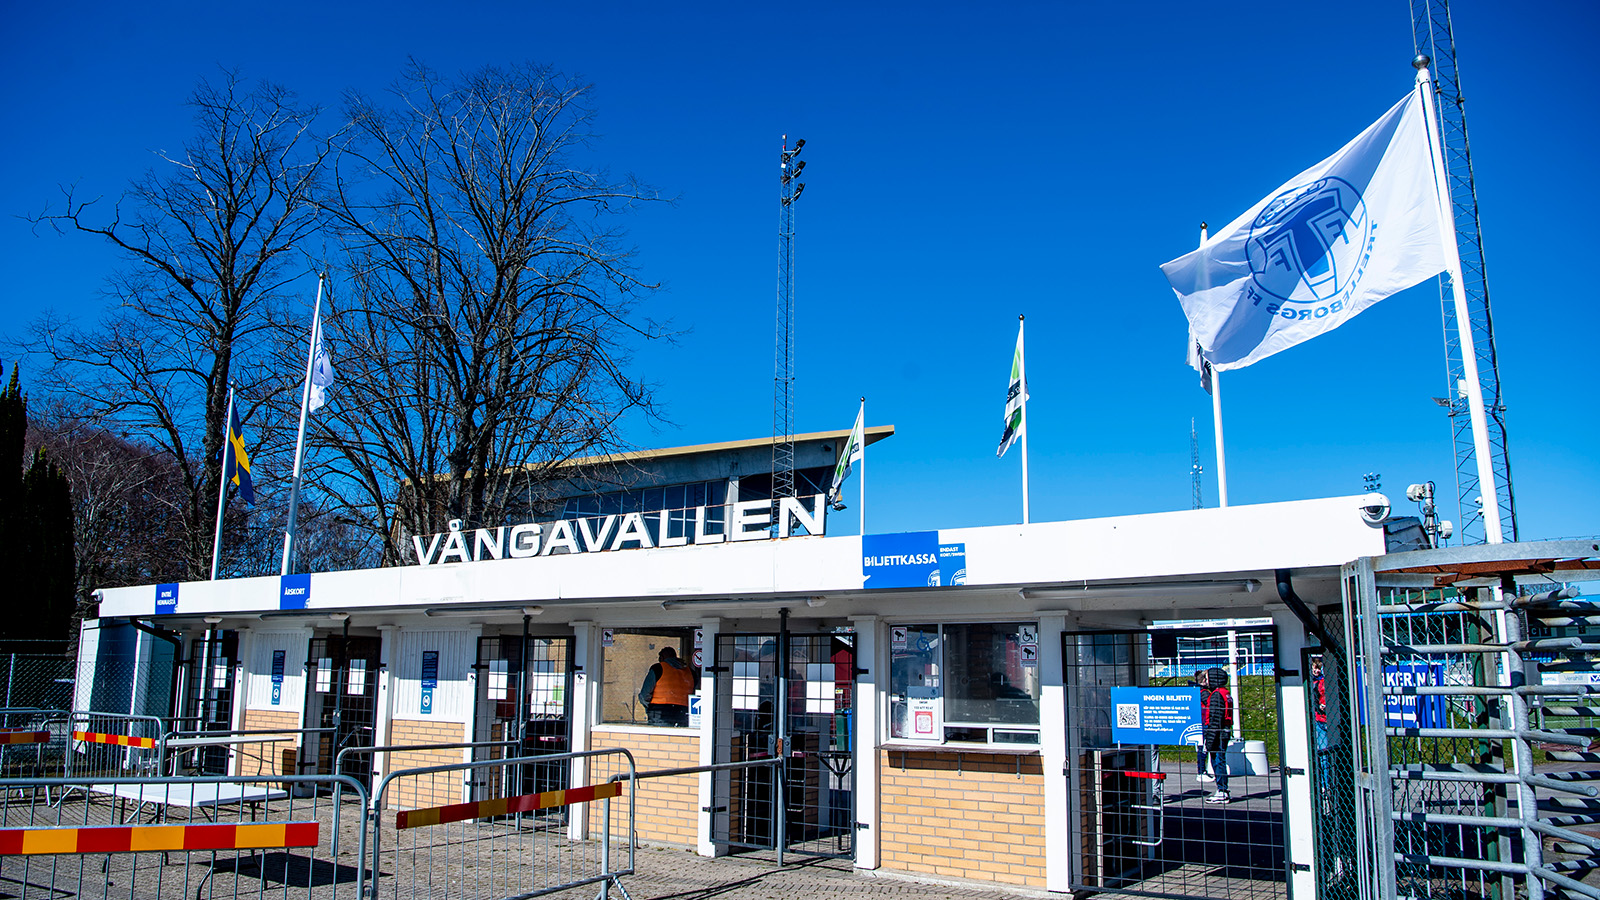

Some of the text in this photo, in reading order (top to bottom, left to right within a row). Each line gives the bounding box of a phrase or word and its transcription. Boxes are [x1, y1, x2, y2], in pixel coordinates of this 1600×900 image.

[412, 493, 826, 566] VÅNGAVALLEN
[864, 554, 938, 567] BILJETTKASSA
[284, 586, 306, 596] ÅRSKORT
